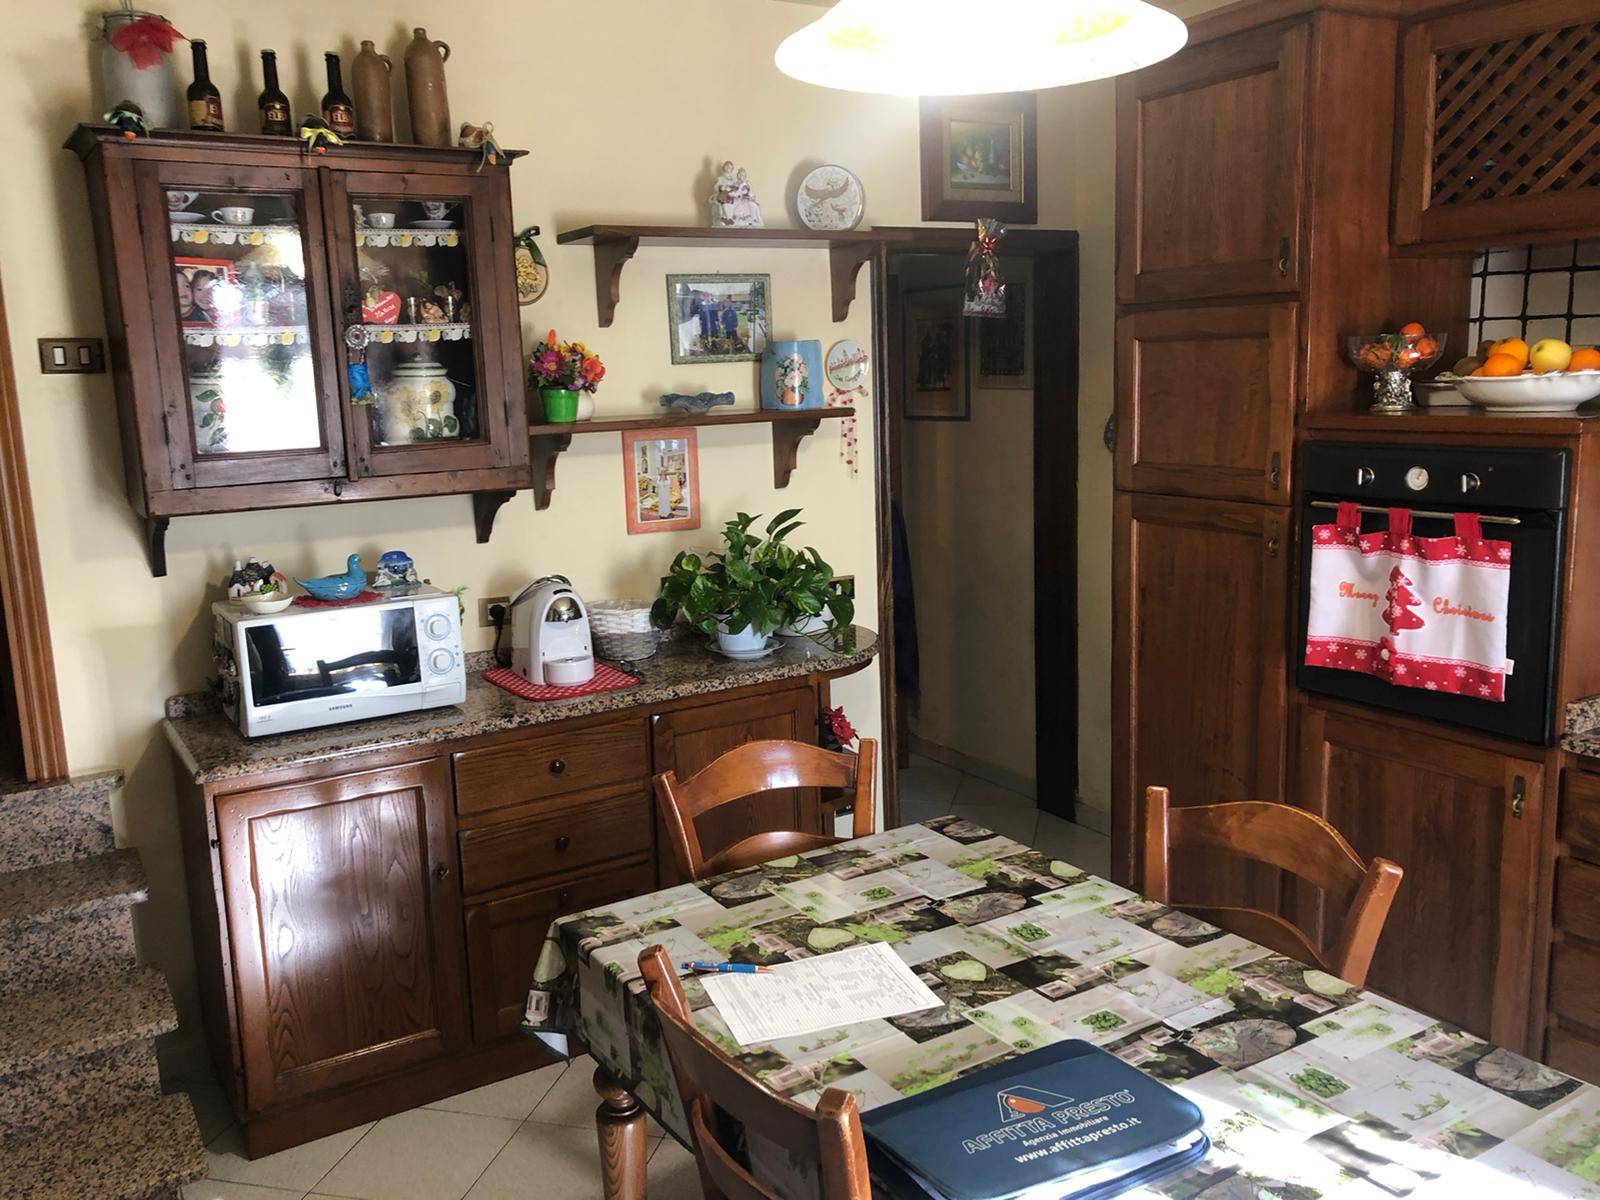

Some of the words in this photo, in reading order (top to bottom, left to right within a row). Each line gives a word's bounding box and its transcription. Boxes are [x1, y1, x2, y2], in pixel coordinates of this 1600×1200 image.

[961, 1117, 1056, 1154] AFFITTA
[1051, 1091, 1136, 1125] PRESTO
[1014, 1117, 1142, 1164] www.affittapresto.it
[1022, 1132, 1058, 1147] Agenzia
[1058, 1115, 1110, 1137] Immobiliare
